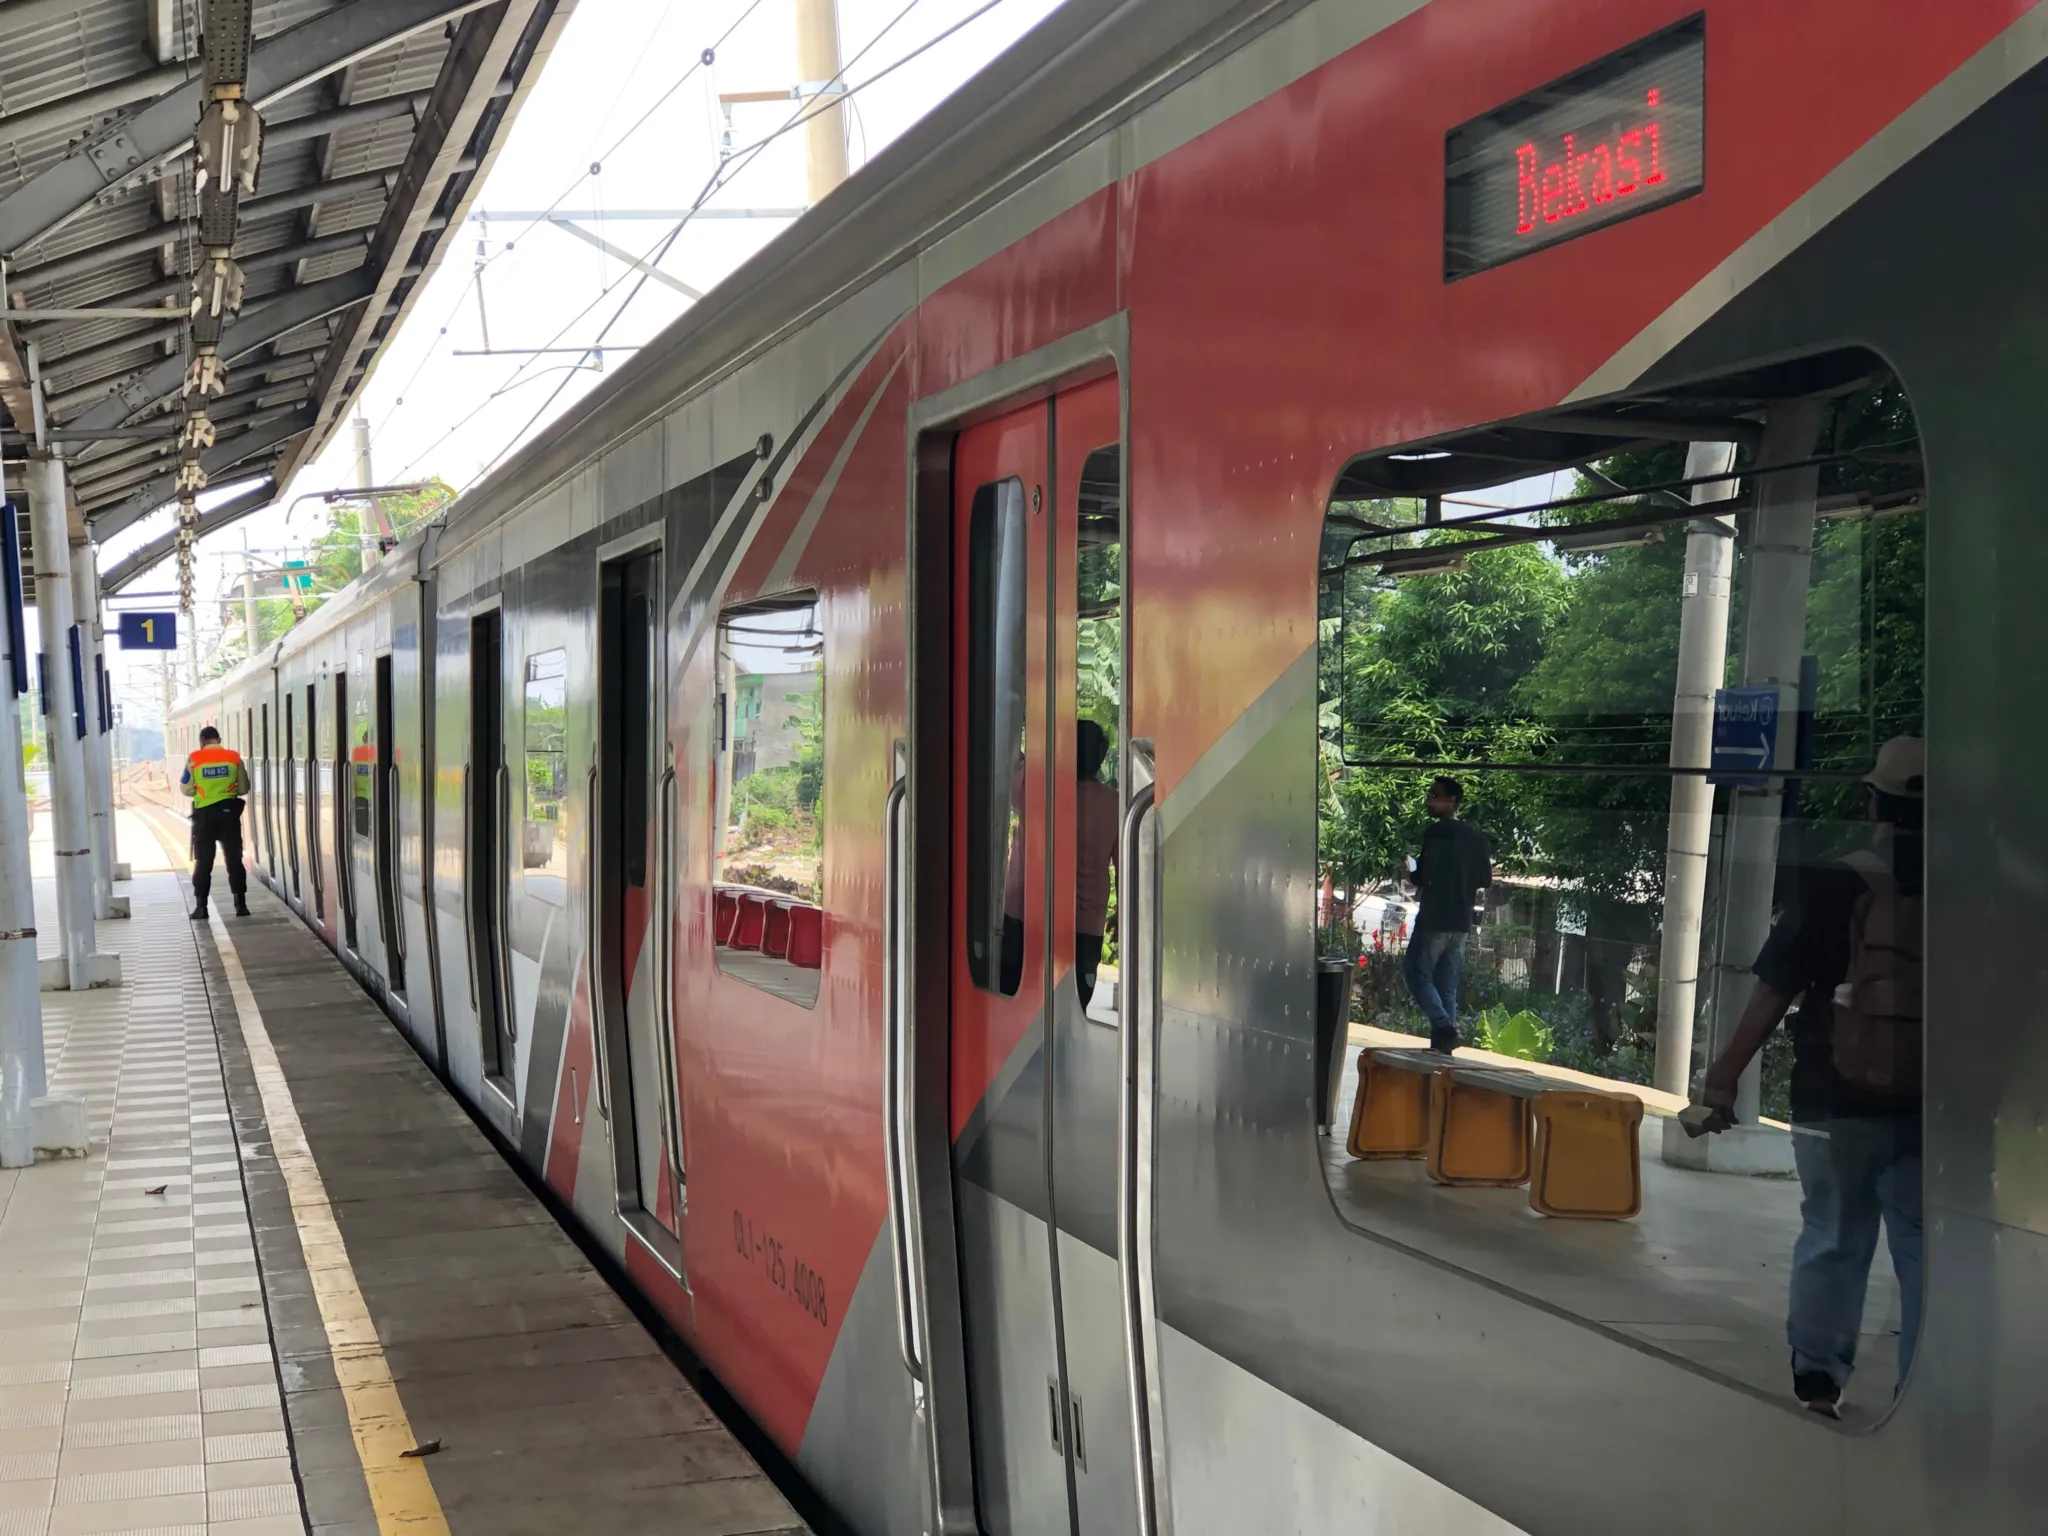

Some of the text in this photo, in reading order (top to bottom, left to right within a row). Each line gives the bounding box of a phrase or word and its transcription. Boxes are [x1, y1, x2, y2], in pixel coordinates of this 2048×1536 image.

[1515, 88, 1667, 234] Bekasi
[140, 618, 154, 643] 1
[204, 768, 215, 776] PAM
